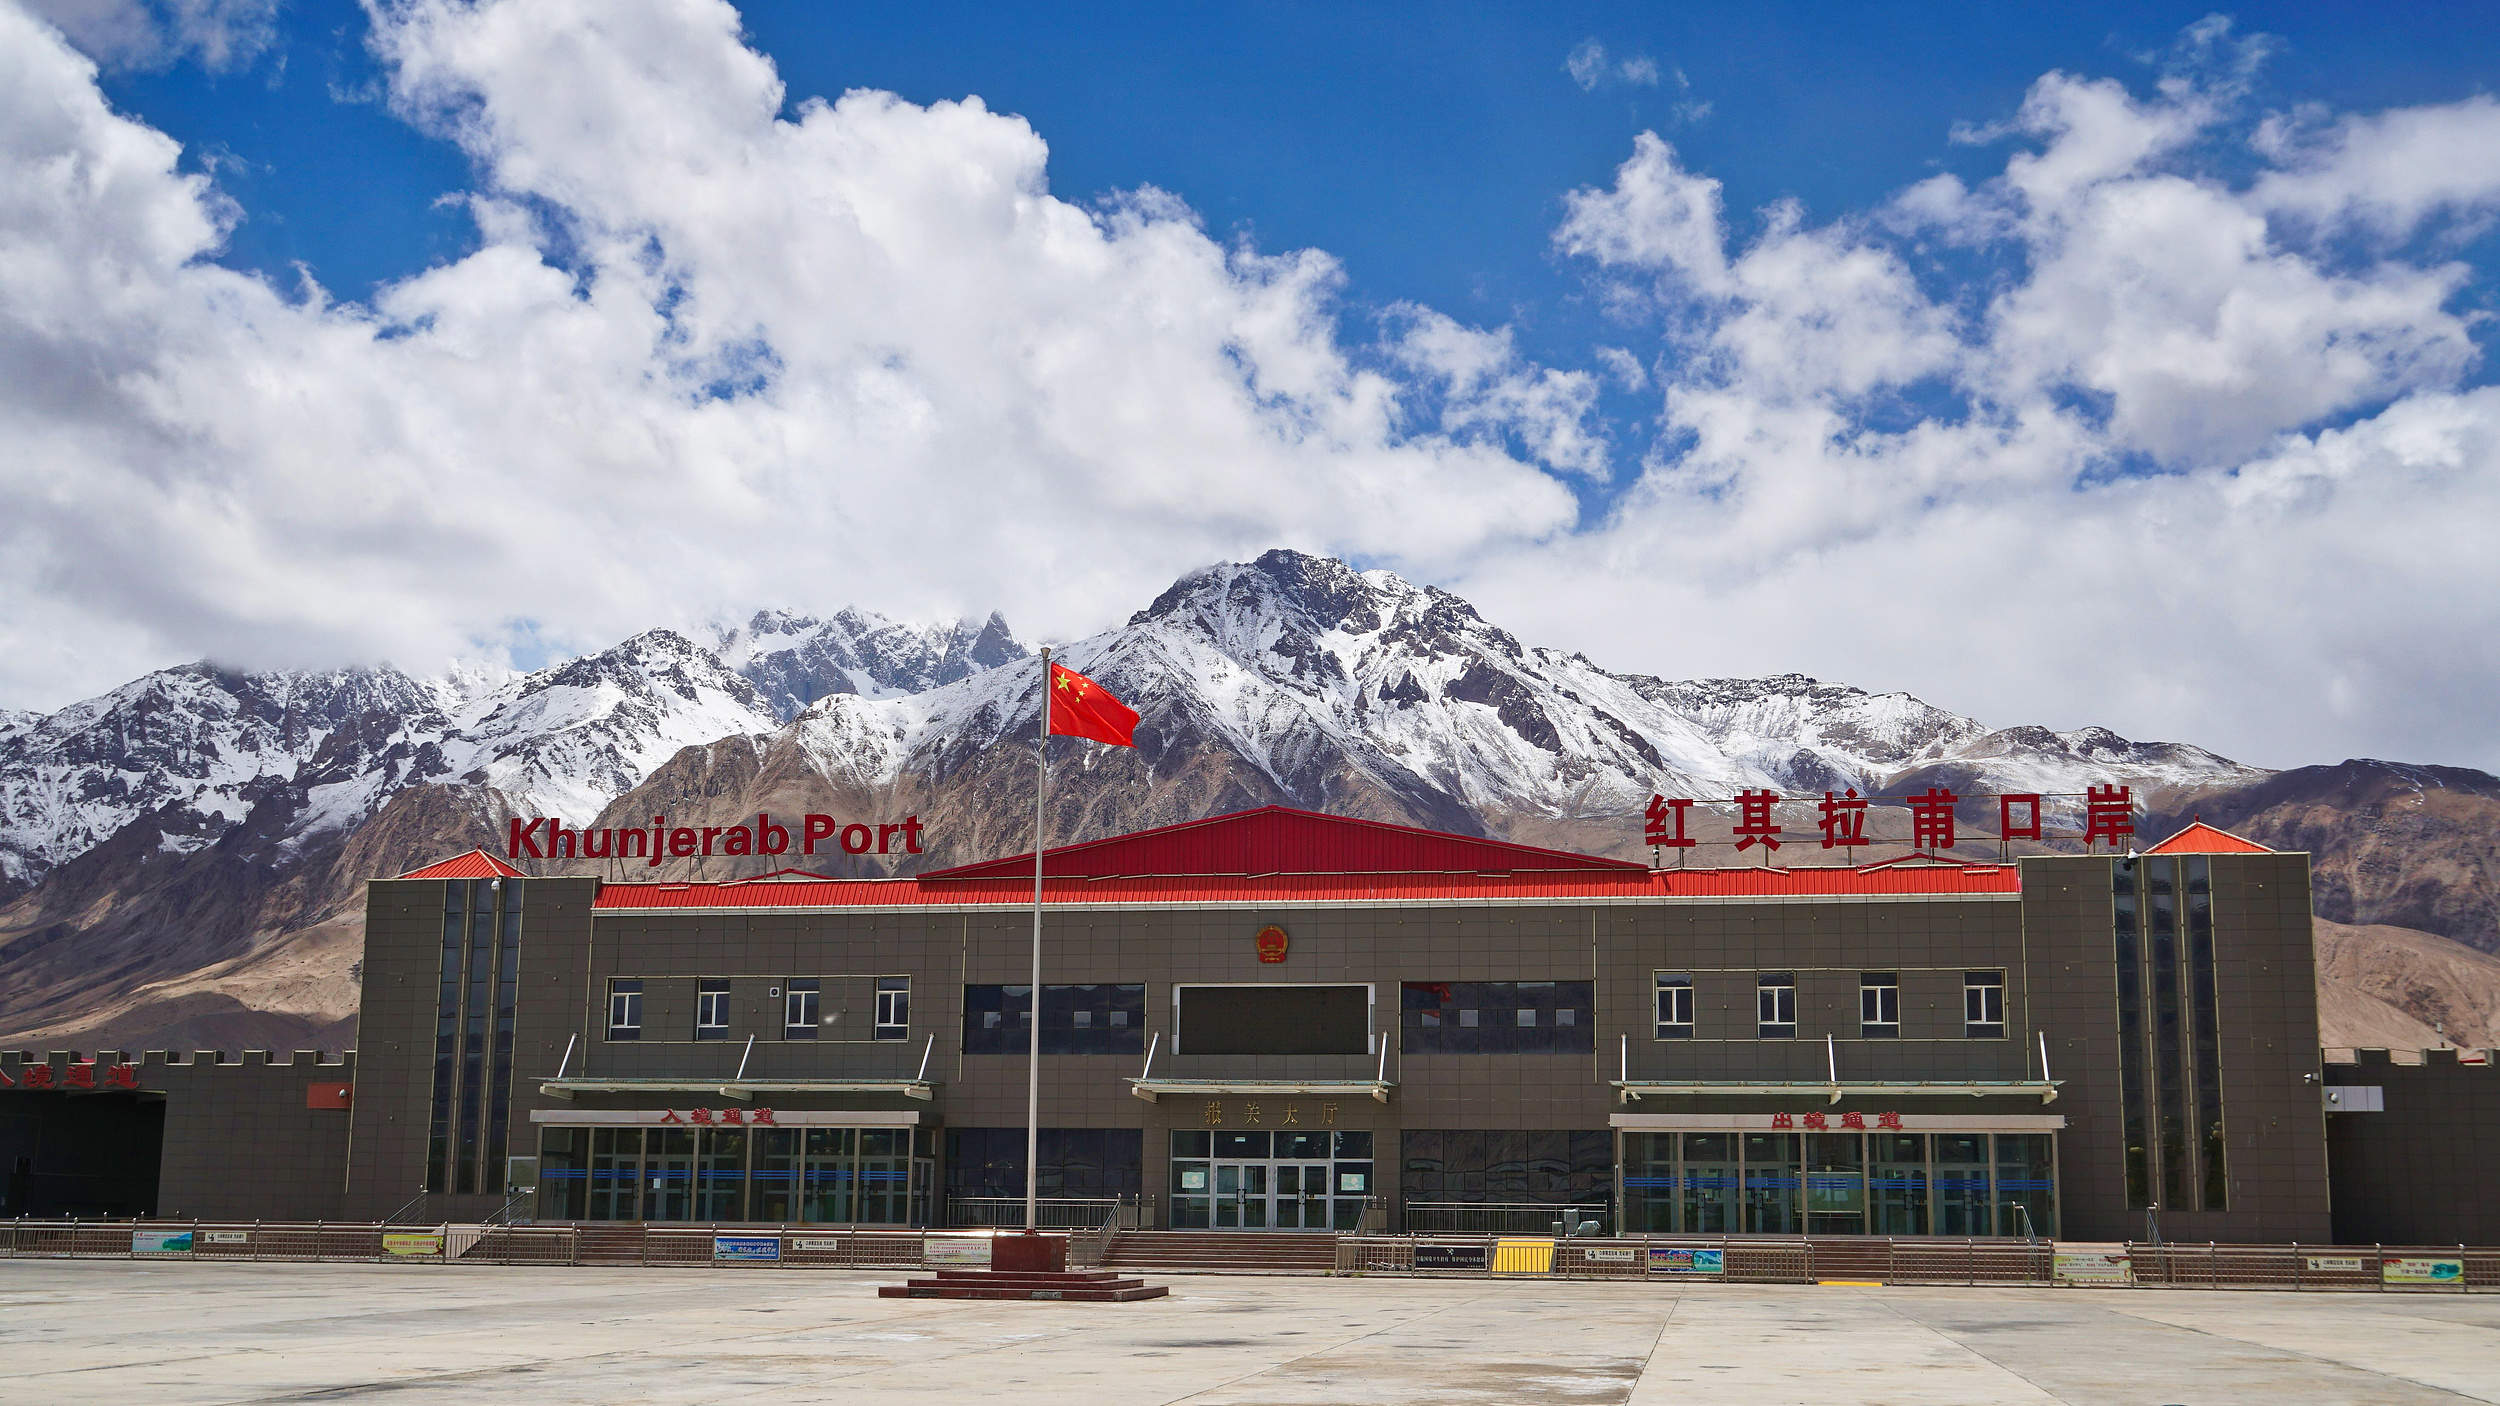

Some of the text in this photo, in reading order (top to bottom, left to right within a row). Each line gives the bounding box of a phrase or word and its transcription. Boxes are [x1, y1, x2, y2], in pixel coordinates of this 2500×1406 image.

[1644, 784, 2135, 852] 红其拉甫口岸
[508, 813, 925, 867] Khunjerab Port
[661, 1107, 775, 1126] 入境通道
[1205, 1101, 1338, 1125] 报关大厅
[1771, 1111, 1904, 1130] 出境通道
